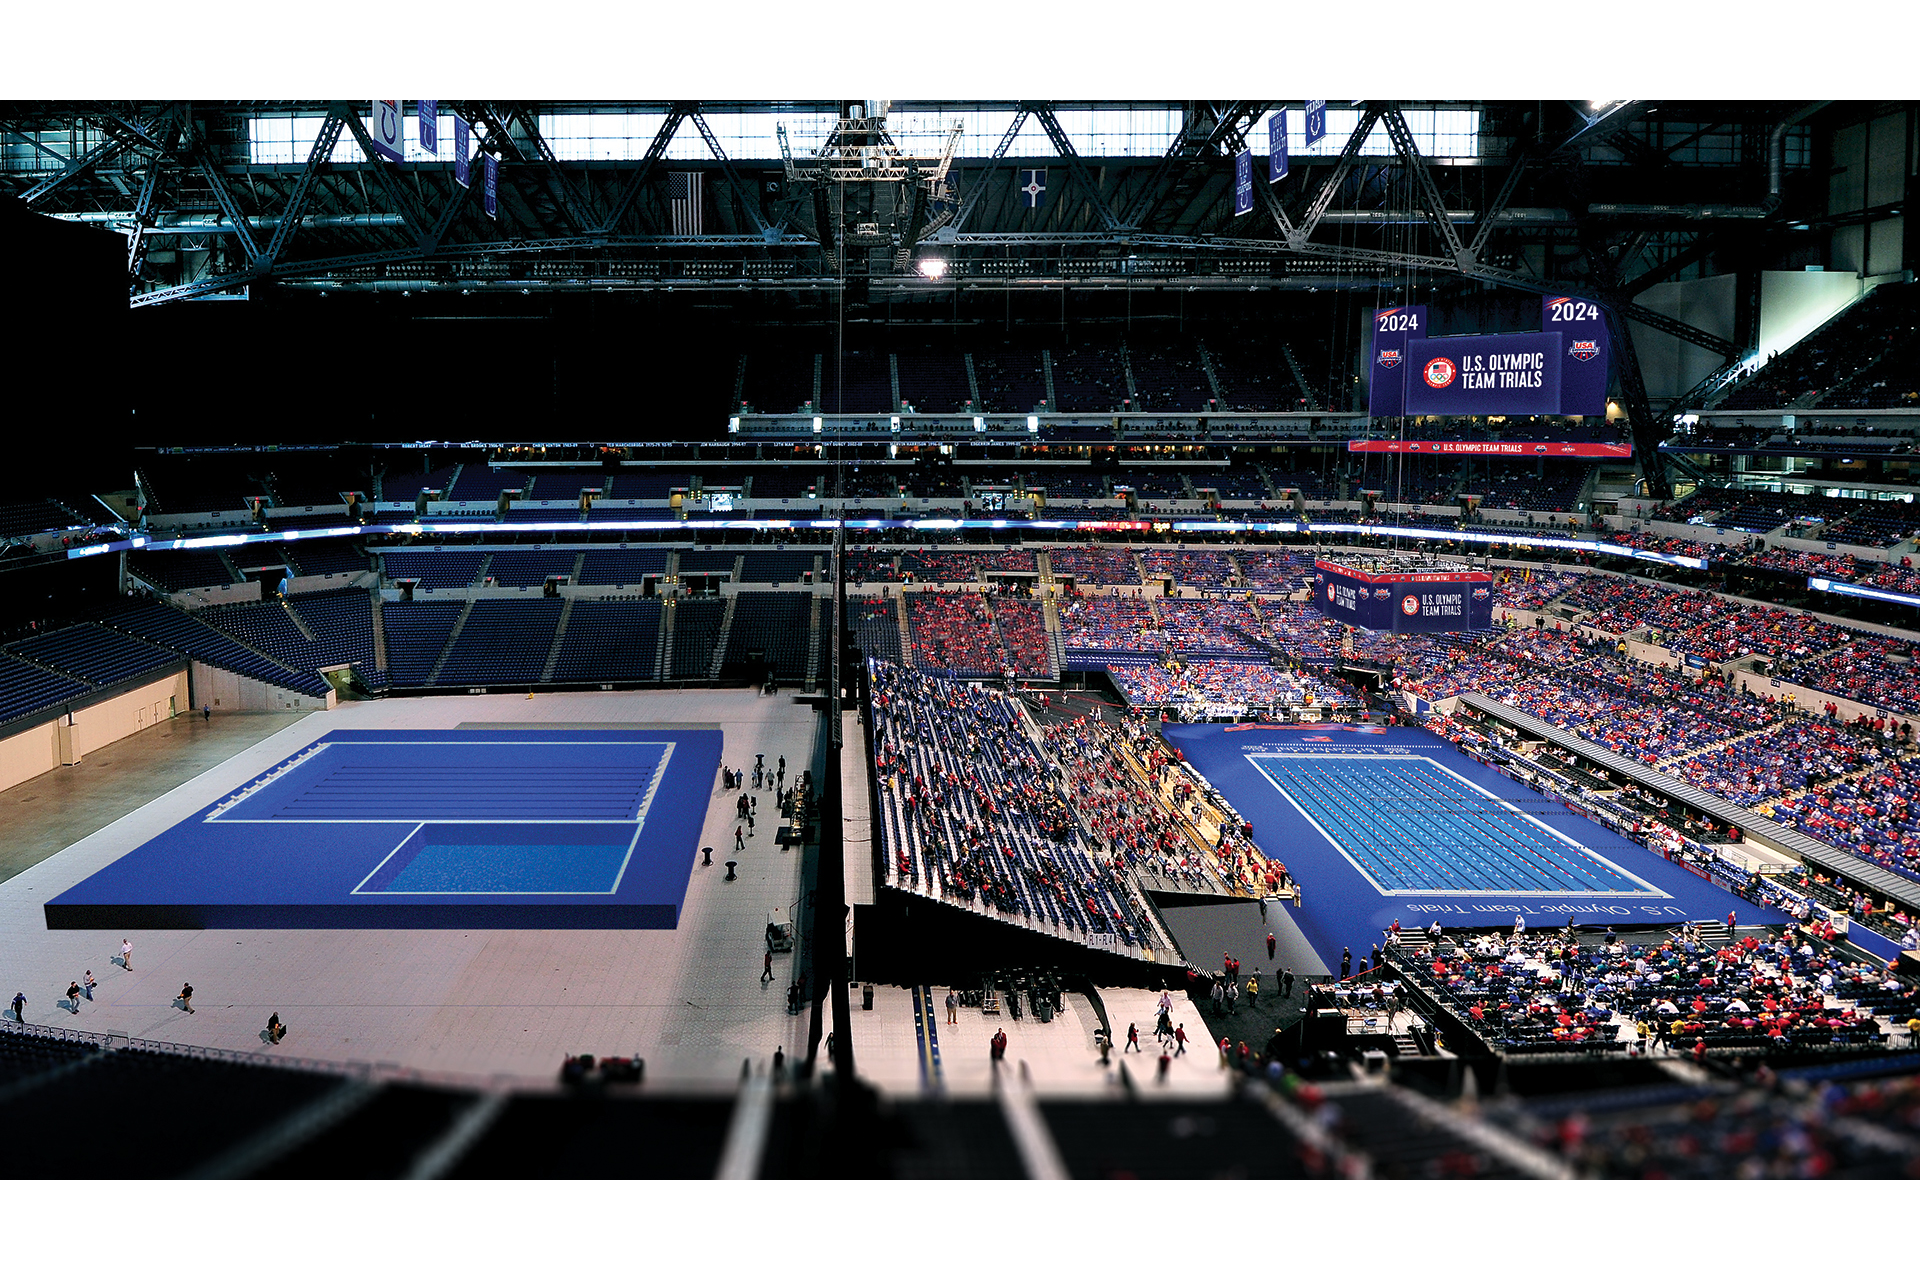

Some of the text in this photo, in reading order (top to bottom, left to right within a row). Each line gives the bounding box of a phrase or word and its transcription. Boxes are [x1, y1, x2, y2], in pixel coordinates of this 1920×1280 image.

[1551, 302, 1599, 322] 2024
[1379, 313, 1418, 332] 2024
[1462, 352, 1544, 372] U.S. OLYMPIC
[1461, 370, 1543, 389] TEAM TRIALS
[1443, 443, 1522, 453] U.S. OLYMPIC TEAM TRIALS
[1422, 593, 1462, 605] U.S. OLYMPIC
[1422, 605, 1462, 616] TEAM TRIALS
[1876, 710, 1888, 718] 127
[1406, 903, 1471, 914] Trials
[1472, 904, 1541, 915] Team
[1540, 903, 1631, 915] Olympic
